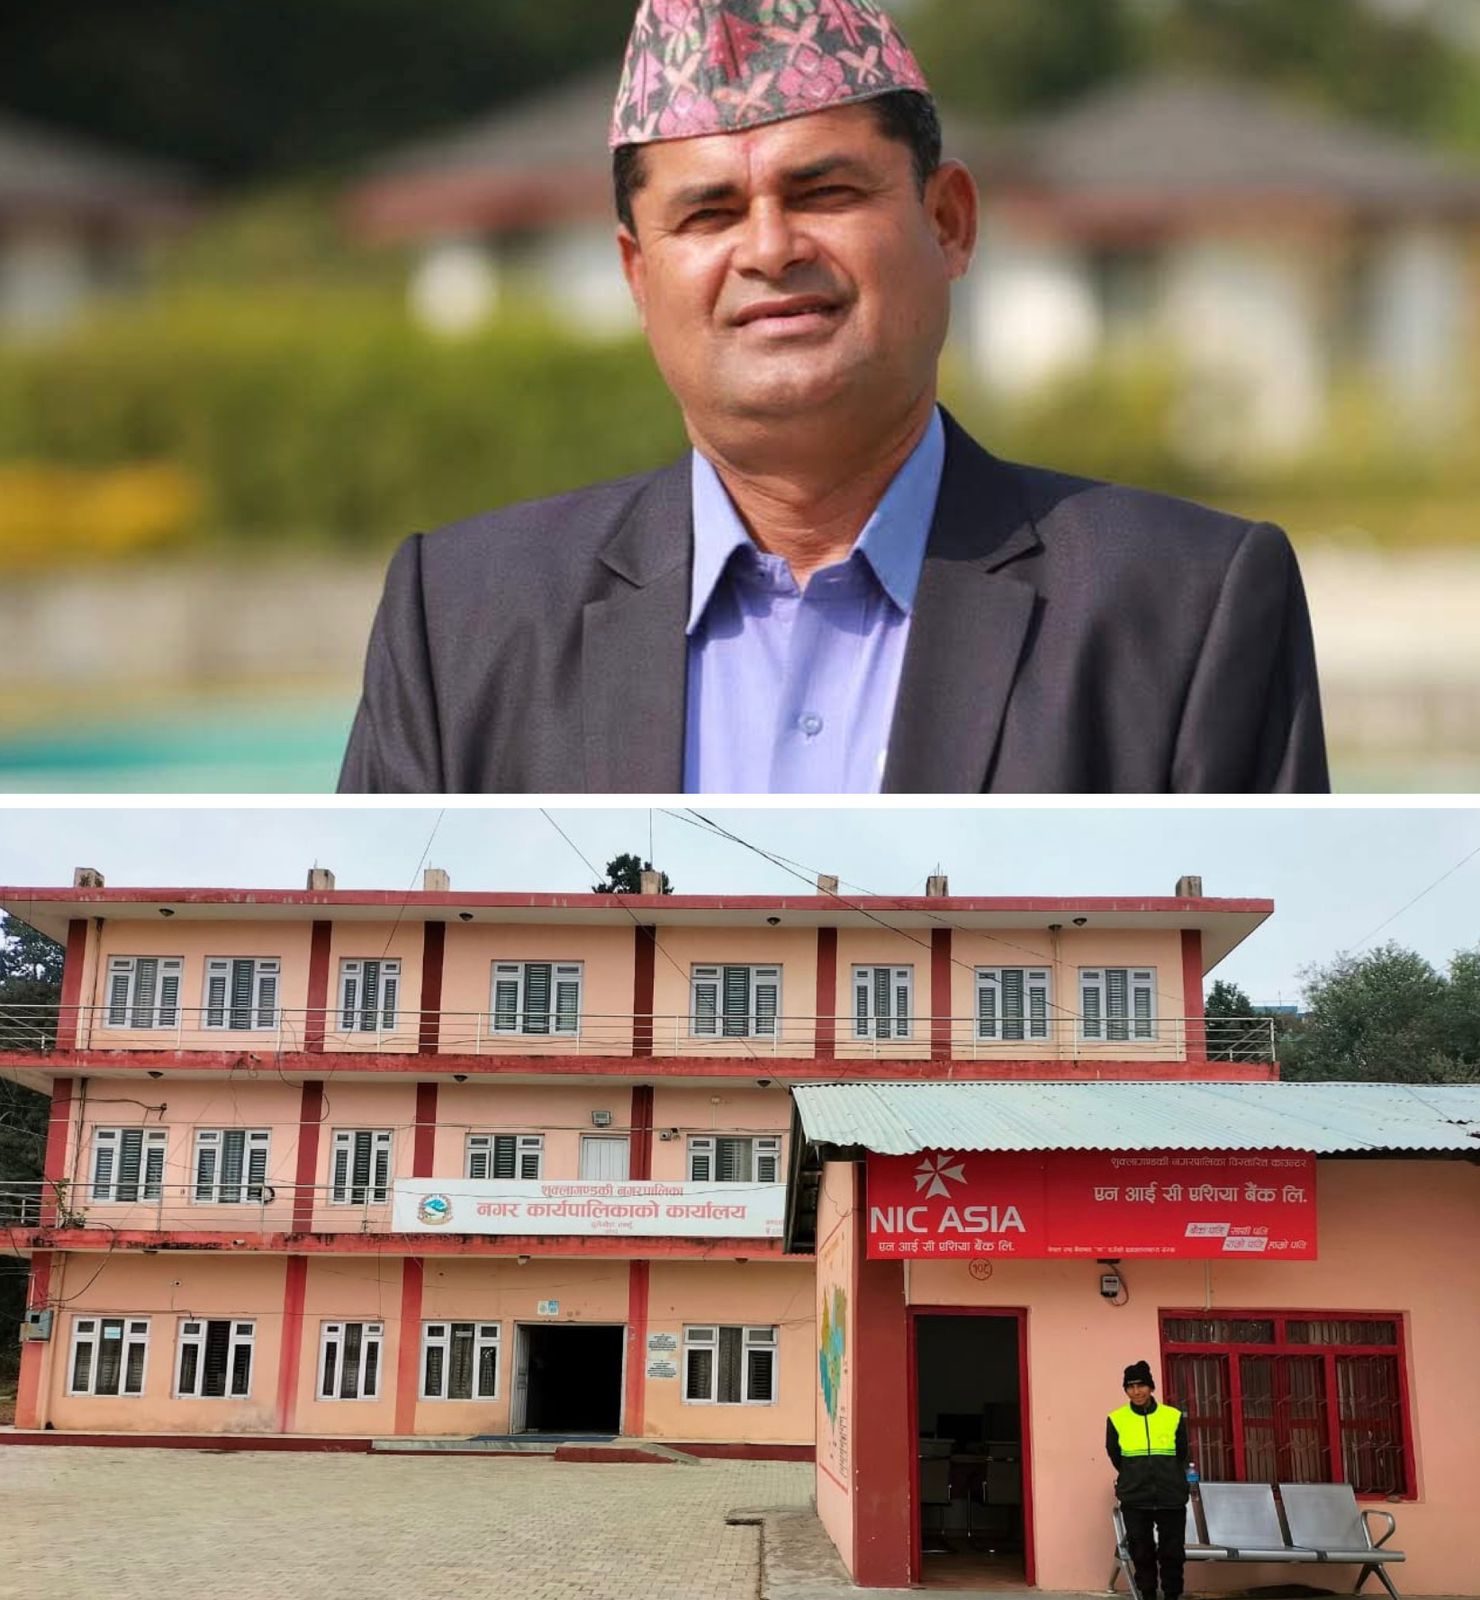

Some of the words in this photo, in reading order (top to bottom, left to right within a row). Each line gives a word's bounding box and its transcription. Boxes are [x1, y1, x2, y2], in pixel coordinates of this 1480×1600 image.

[1171, 1156, 1226, 1168] नगरपालिका
[1094, 1187, 1120, 1201] एन
[1125, 1181, 1157, 1203] आई
[1162, 1184, 1183, 1202] सी
[1188, 1184, 1239, 1202] एशिया
[1245, 1181, 1277, 1202] बैंक
[1281, 1185, 1307, 1203] लि.
[476, 1201, 521, 1217] नगर
[526, 1200, 659, 1219] कार्यपालिकाको
[666, 1201, 747, 1220] कार्यालय
[870, 1206, 928, 1233] NIC
[937, 1206, 1026, 1233] ASIA
[879, 1242, 894, 1252] एन
[898, 1239, 918, 1252] आई
[922, 1240, 935, 1252] सी
[939, 1240, 970, 1252] एशिया
[974, 1239, 994, 1252] बैंक
